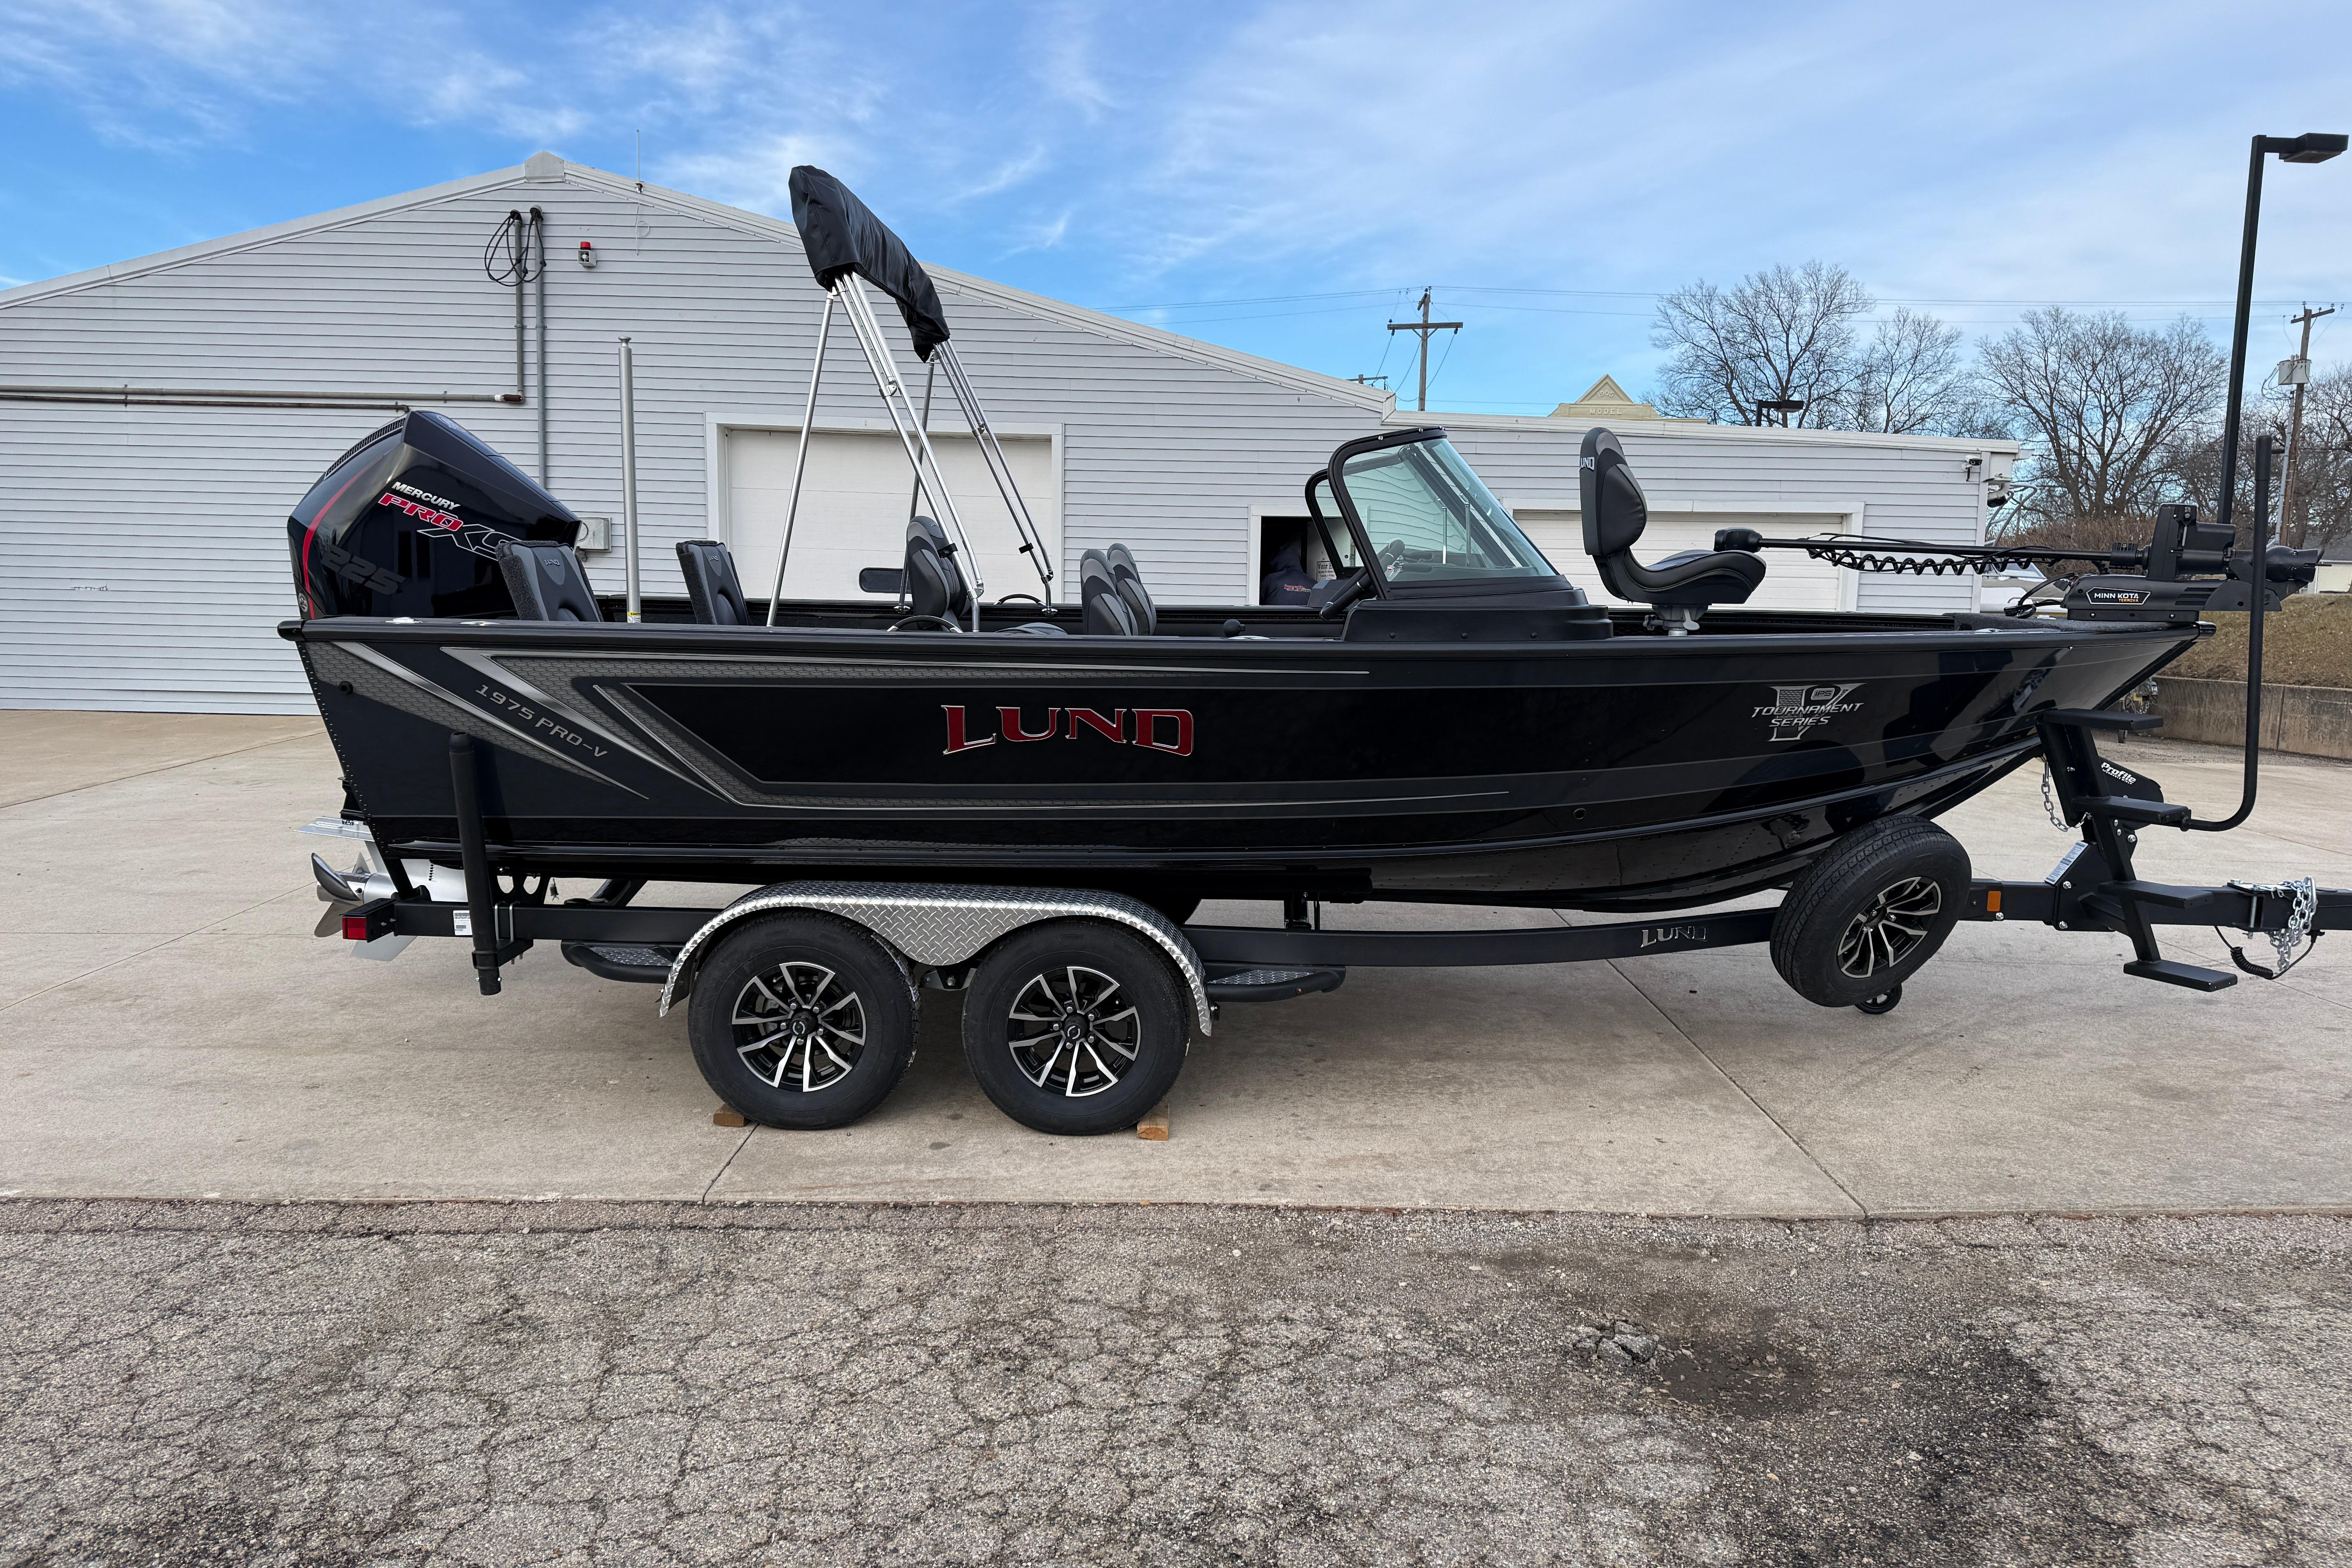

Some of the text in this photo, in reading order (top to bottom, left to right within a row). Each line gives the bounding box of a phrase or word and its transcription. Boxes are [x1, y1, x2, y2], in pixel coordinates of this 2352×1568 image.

[1580, 457, 1595, 470] UND
[392, 481, 461, 510] MERCURY
[378, 492, 464, 531] PRO
[321, 544, 407, 595] 225
[475, 684, 608, 757] 1975 PRO-V
[1752, 702, 1864, 718] TOURNAMENT
[1769, 716, 1831, 727] SERIES
[940, 705, 1194, 756] LUND
[2101, 762, 2136, 783] Profile
[1640, 926, 1709, 948] LUND
